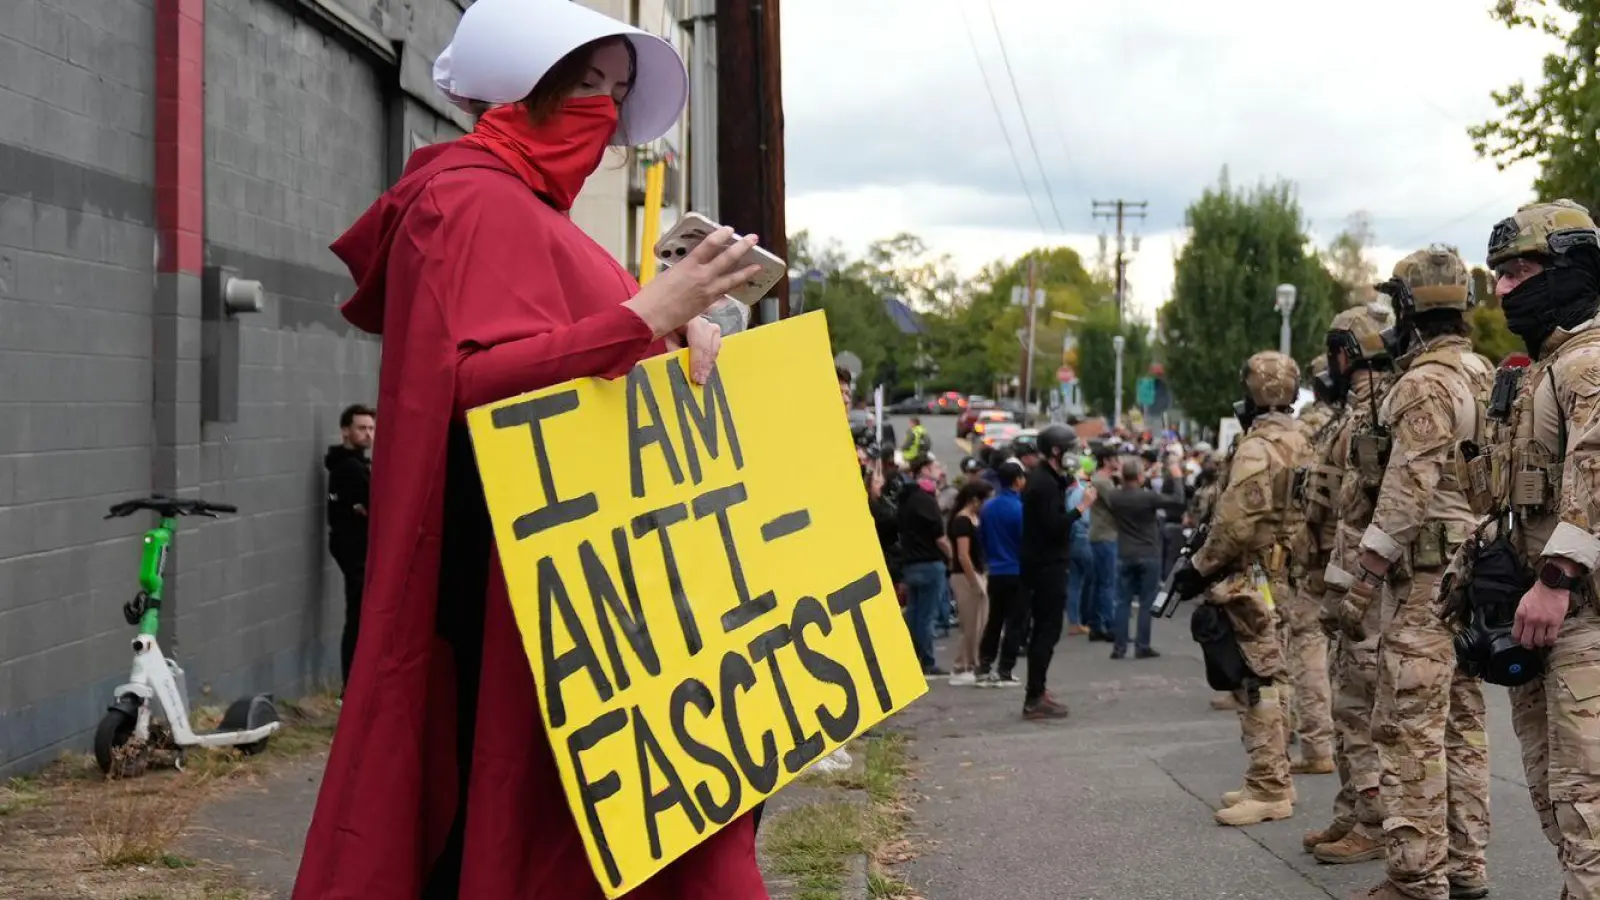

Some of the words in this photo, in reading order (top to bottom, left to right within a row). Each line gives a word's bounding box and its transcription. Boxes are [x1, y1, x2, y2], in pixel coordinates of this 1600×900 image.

[491, 390, 598, 539] I
[625, 357, 744, 497] AM
[537, 482, 810, 727] ANTI-
[567, 571, 892, 887] FASCIST
